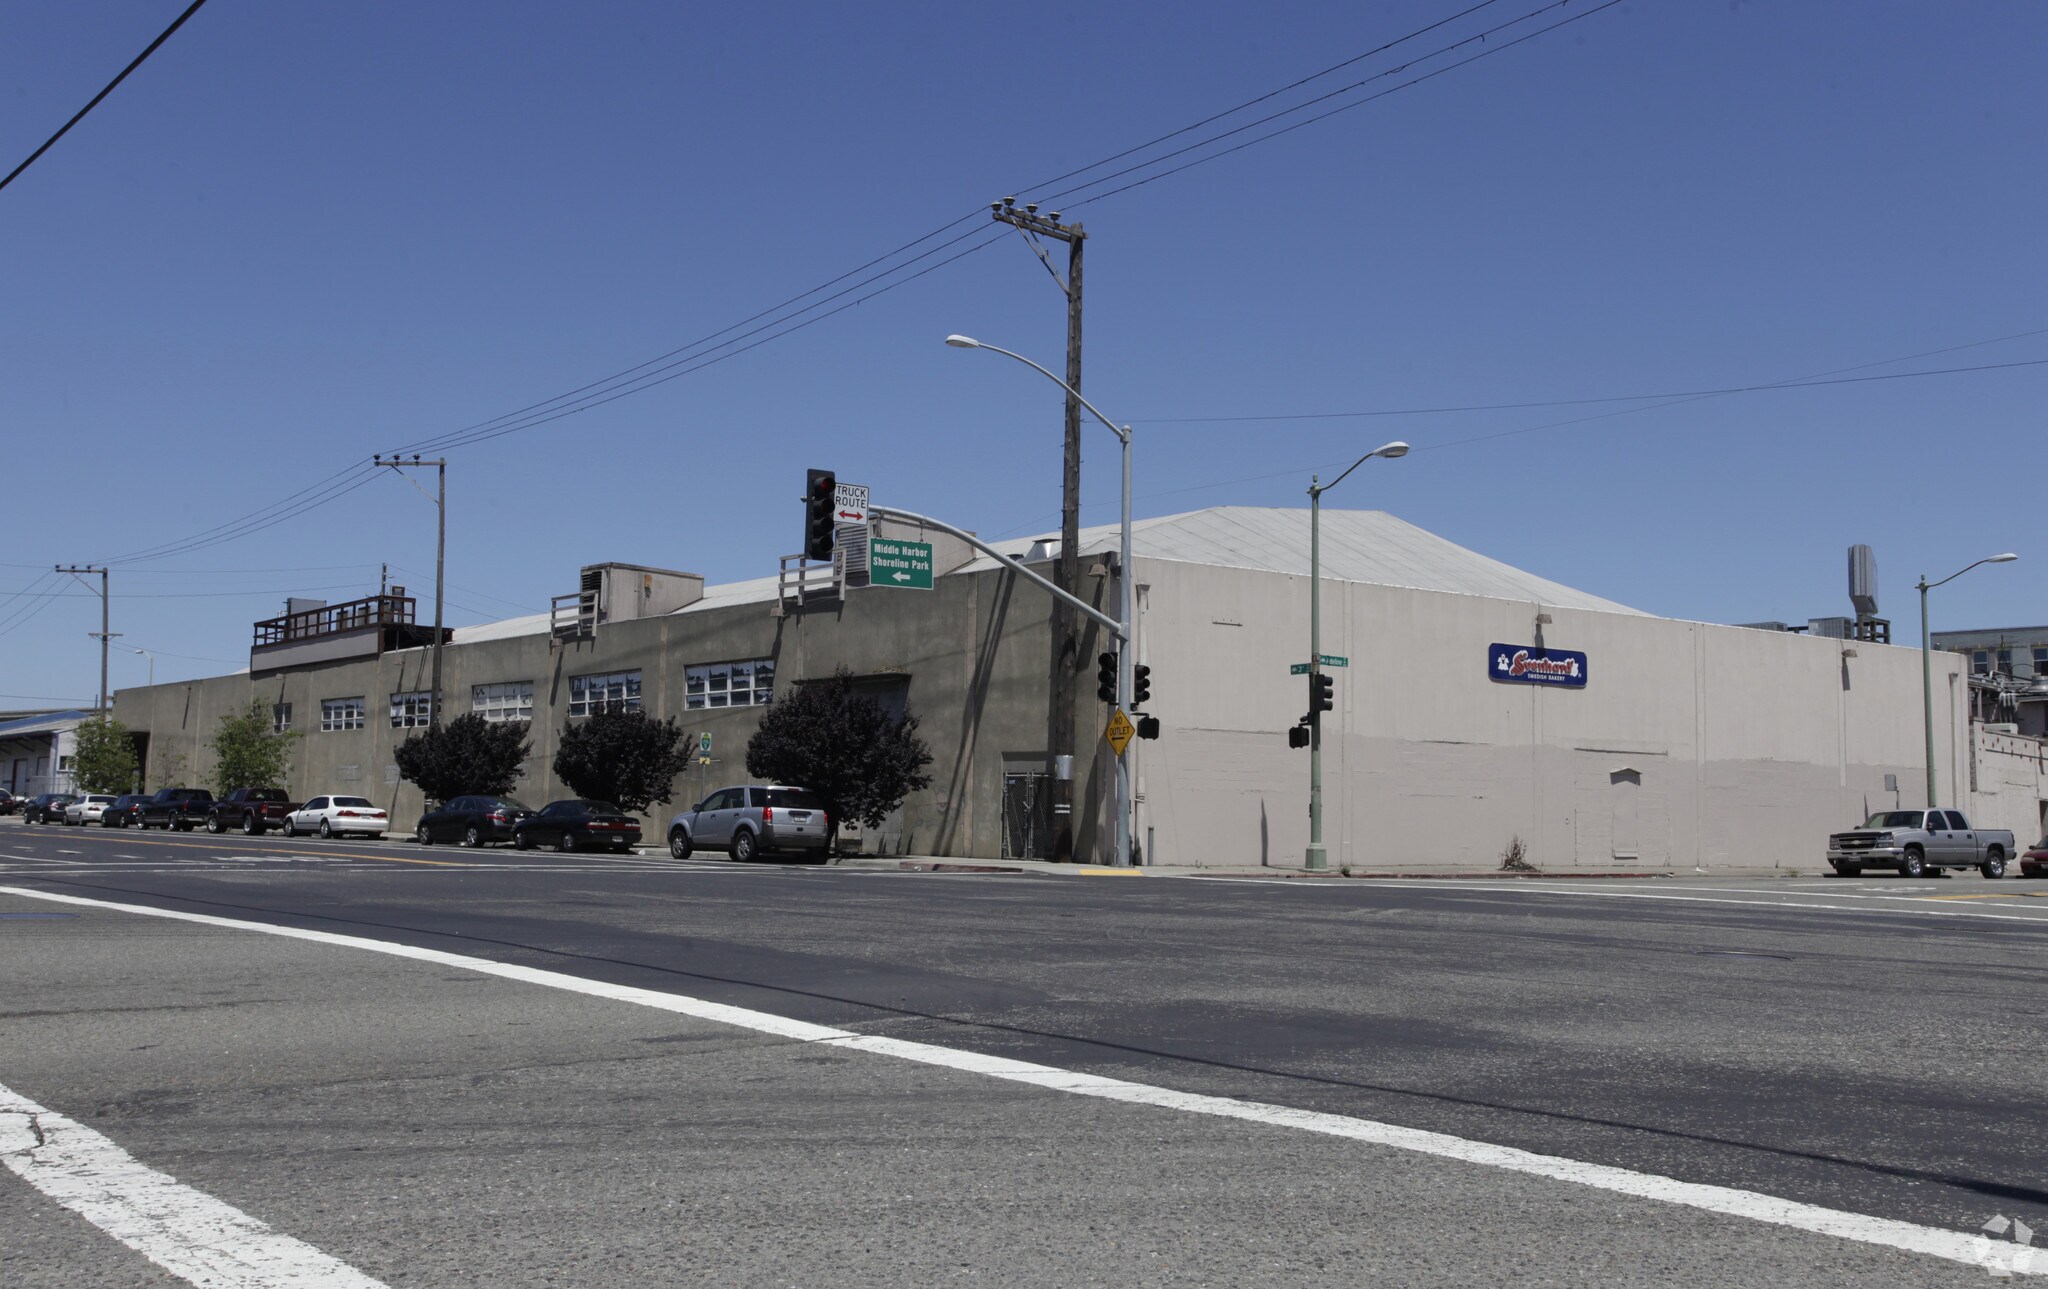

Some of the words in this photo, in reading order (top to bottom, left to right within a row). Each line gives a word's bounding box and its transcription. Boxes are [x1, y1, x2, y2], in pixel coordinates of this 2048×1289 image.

[837, 485, 866, 498] TRUCK
[836, 496, 866, 509] ROUTE
[874, 543, 899, 555] Middle
[902, 546, 927, 557] Harbor
[873, 557, 909, 569] Shoreline
[912, 560, 929, 570] Park
[1114, 716, 1123, 725] NO
[1110, 726, 1130, 736] OUTLET
